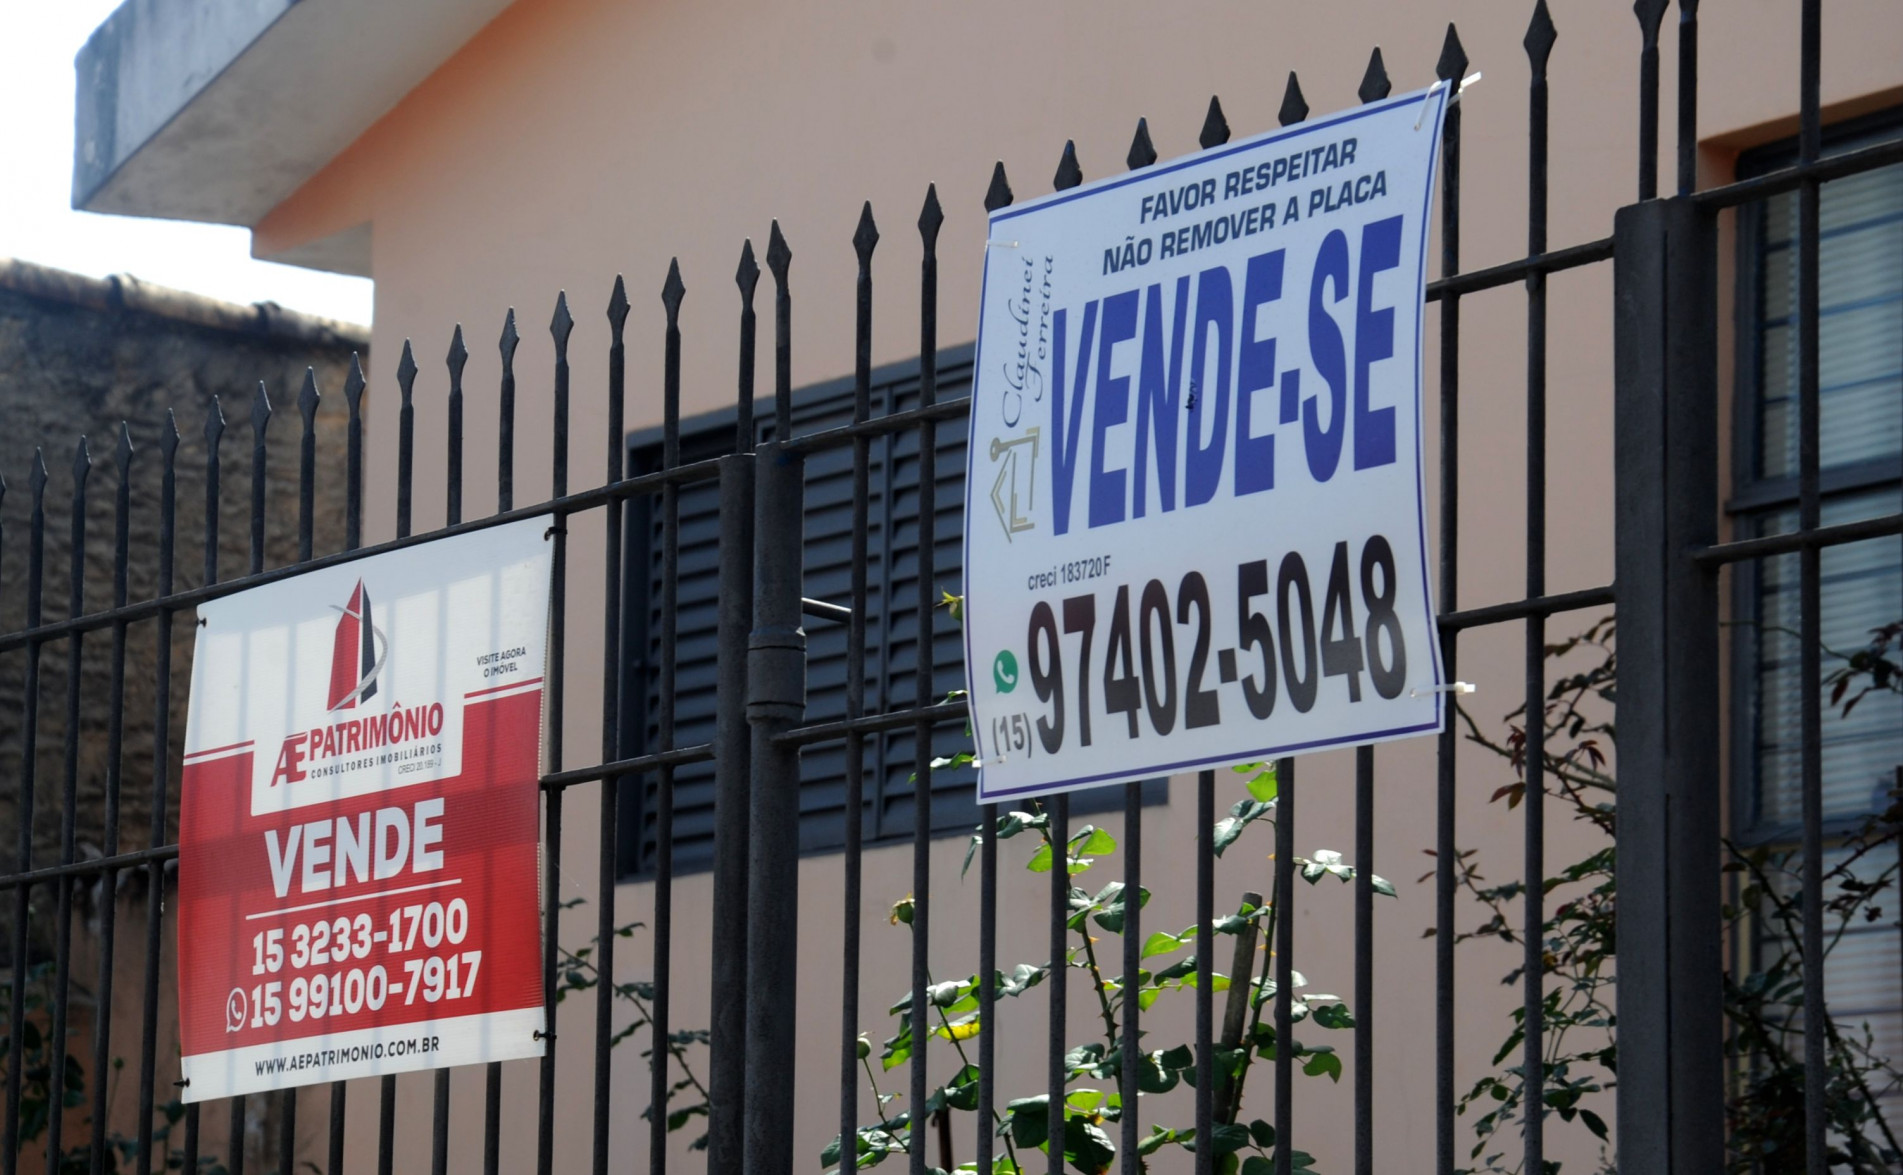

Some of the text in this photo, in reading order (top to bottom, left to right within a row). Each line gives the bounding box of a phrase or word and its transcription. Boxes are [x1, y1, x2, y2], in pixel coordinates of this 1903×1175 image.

[1139, 136, 1358, 225] FAVOR RESPEITAR
[1101, 170, 1388, 276] NÃO REMOVER A PLACA
[1002, 256, 1034, 428] Claudinei
[1025, 255, 1054, 403] Ferreira
[1052, 213, 1404, 537] VENDE-SE
[1027, 555, 1111, 591] creci 183720F
[476, 646, 526, 666] VISITE AGORA
[483, 661, 518, 678] O IMÓVEL
[992, 534, 1407, 759] (15) 97402-5048
[311, 743, 442, 779] CONSULTORES IMOBILIÁRIOS
[397, 763, 415, 775] CRECI
[264, 797, 445, 899] VENDE
[252, 897, 468, 976] 15 3233-1700
[250, 950, 482, 1029] 15 99100-7917
[255, 1036, 440, 1077] WWW.AEPATRIMONIO.COM.BR
